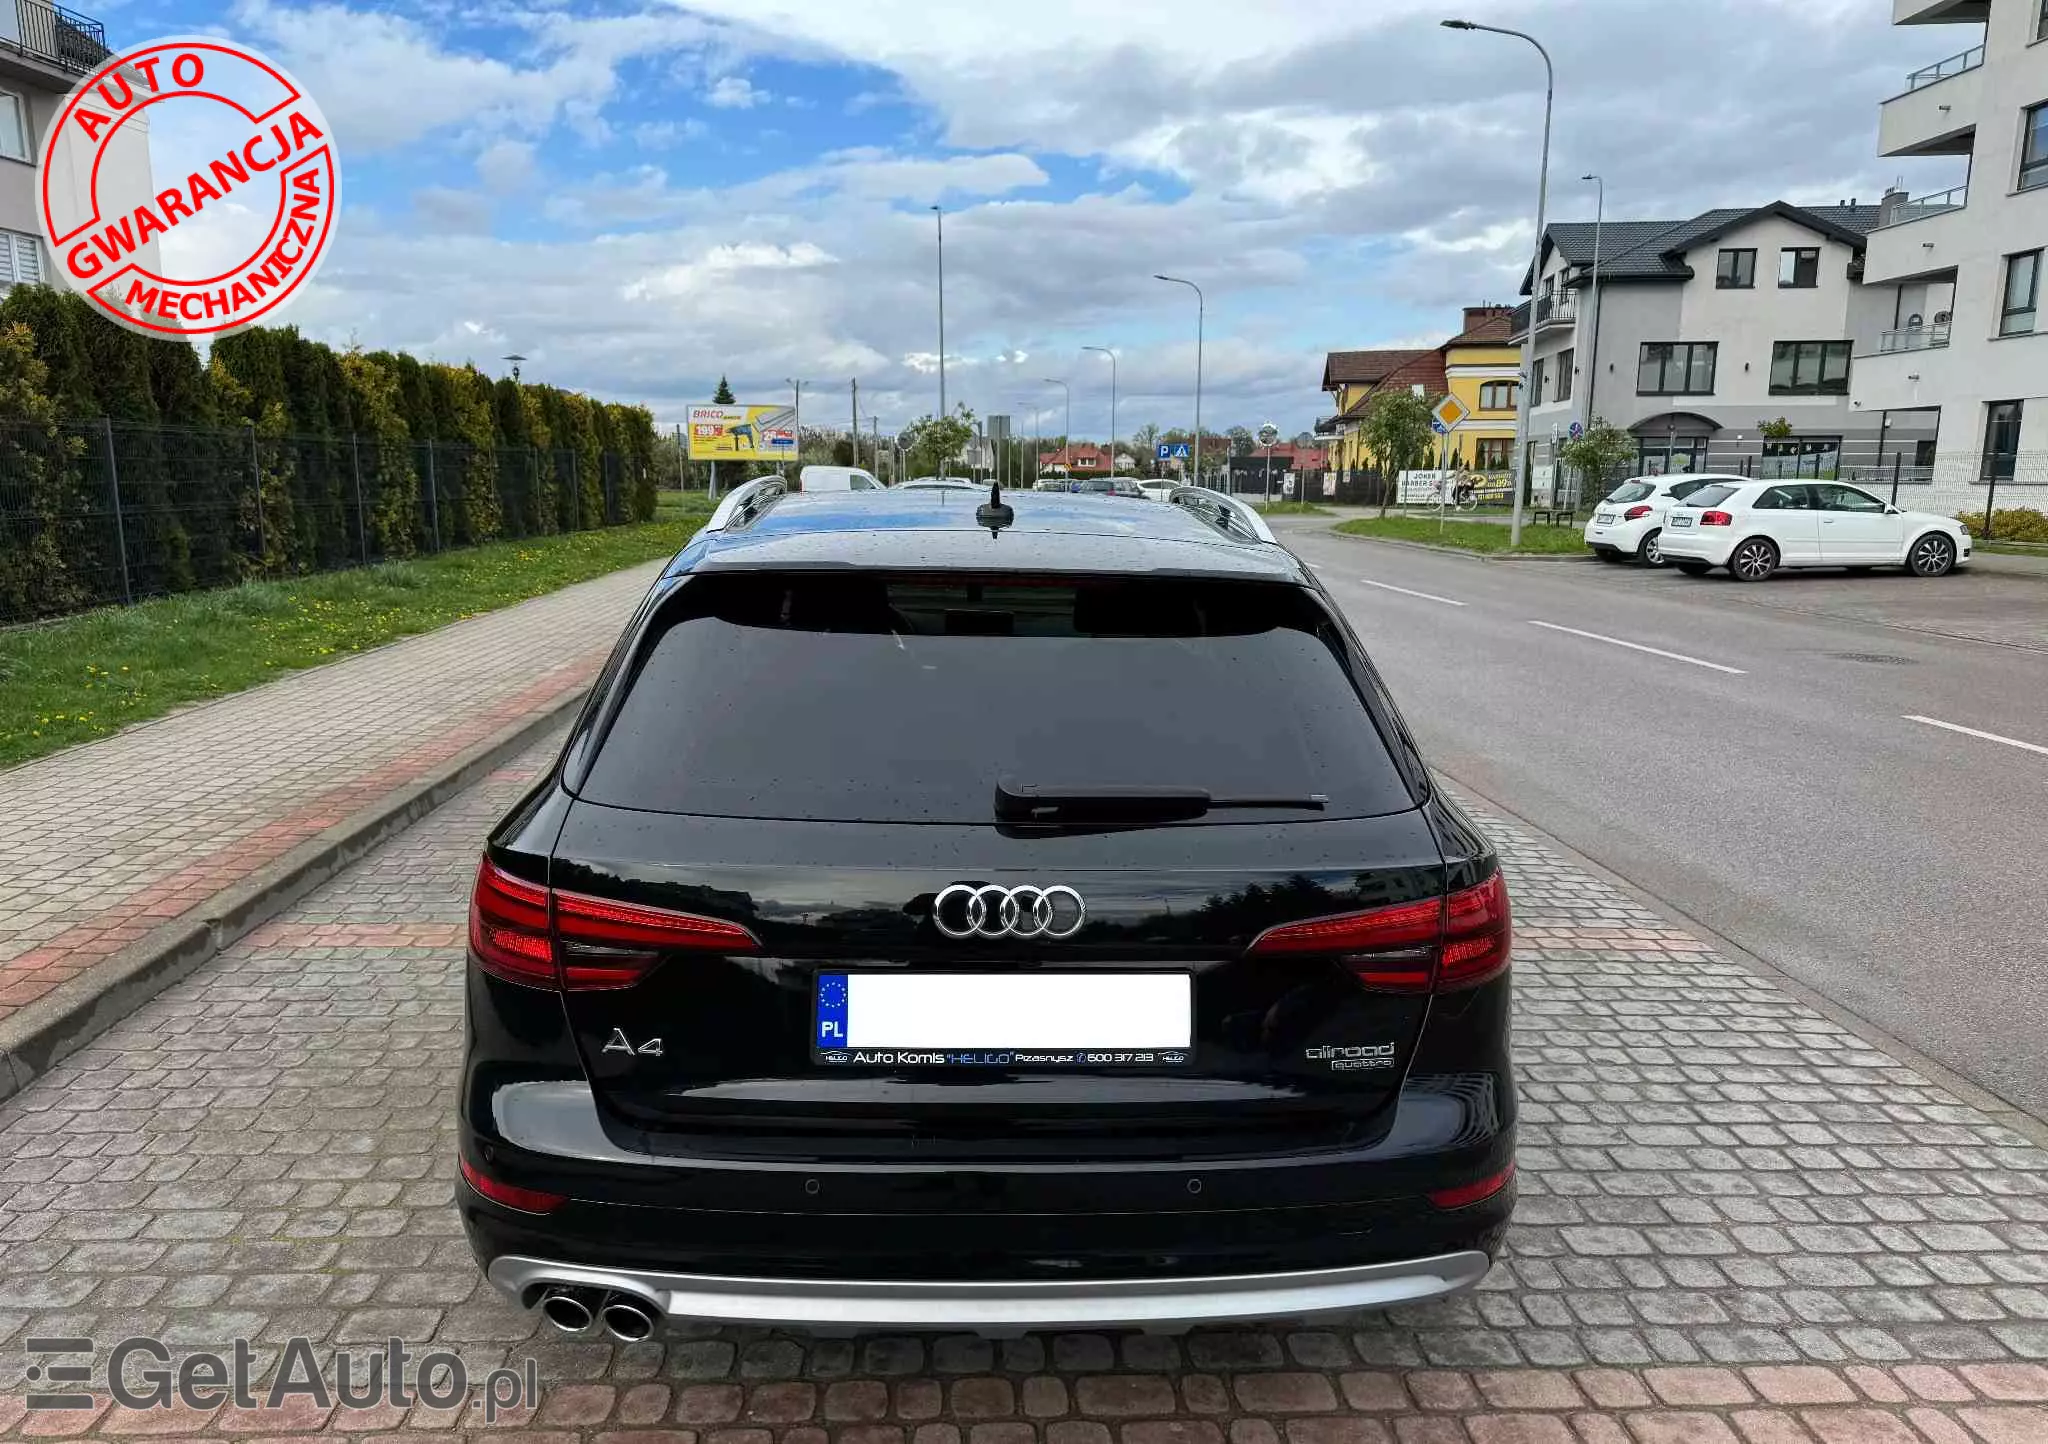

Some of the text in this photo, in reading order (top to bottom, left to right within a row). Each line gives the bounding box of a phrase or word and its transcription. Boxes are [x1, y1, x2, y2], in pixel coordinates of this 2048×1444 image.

[1160, 445, 1169, 457] P
[821, 1021, 844, 1038] PL
[601, 1027, 664, 1057] A4
[853, 1051, 894, 1064] Auto
[897, 1051, 945, 1064] Komis
[1087, 1053, 1113, 1062] 600
[1305, 1042, 1395, 1059] allroad
[1333, 1060, 1393, 1070] quattro
